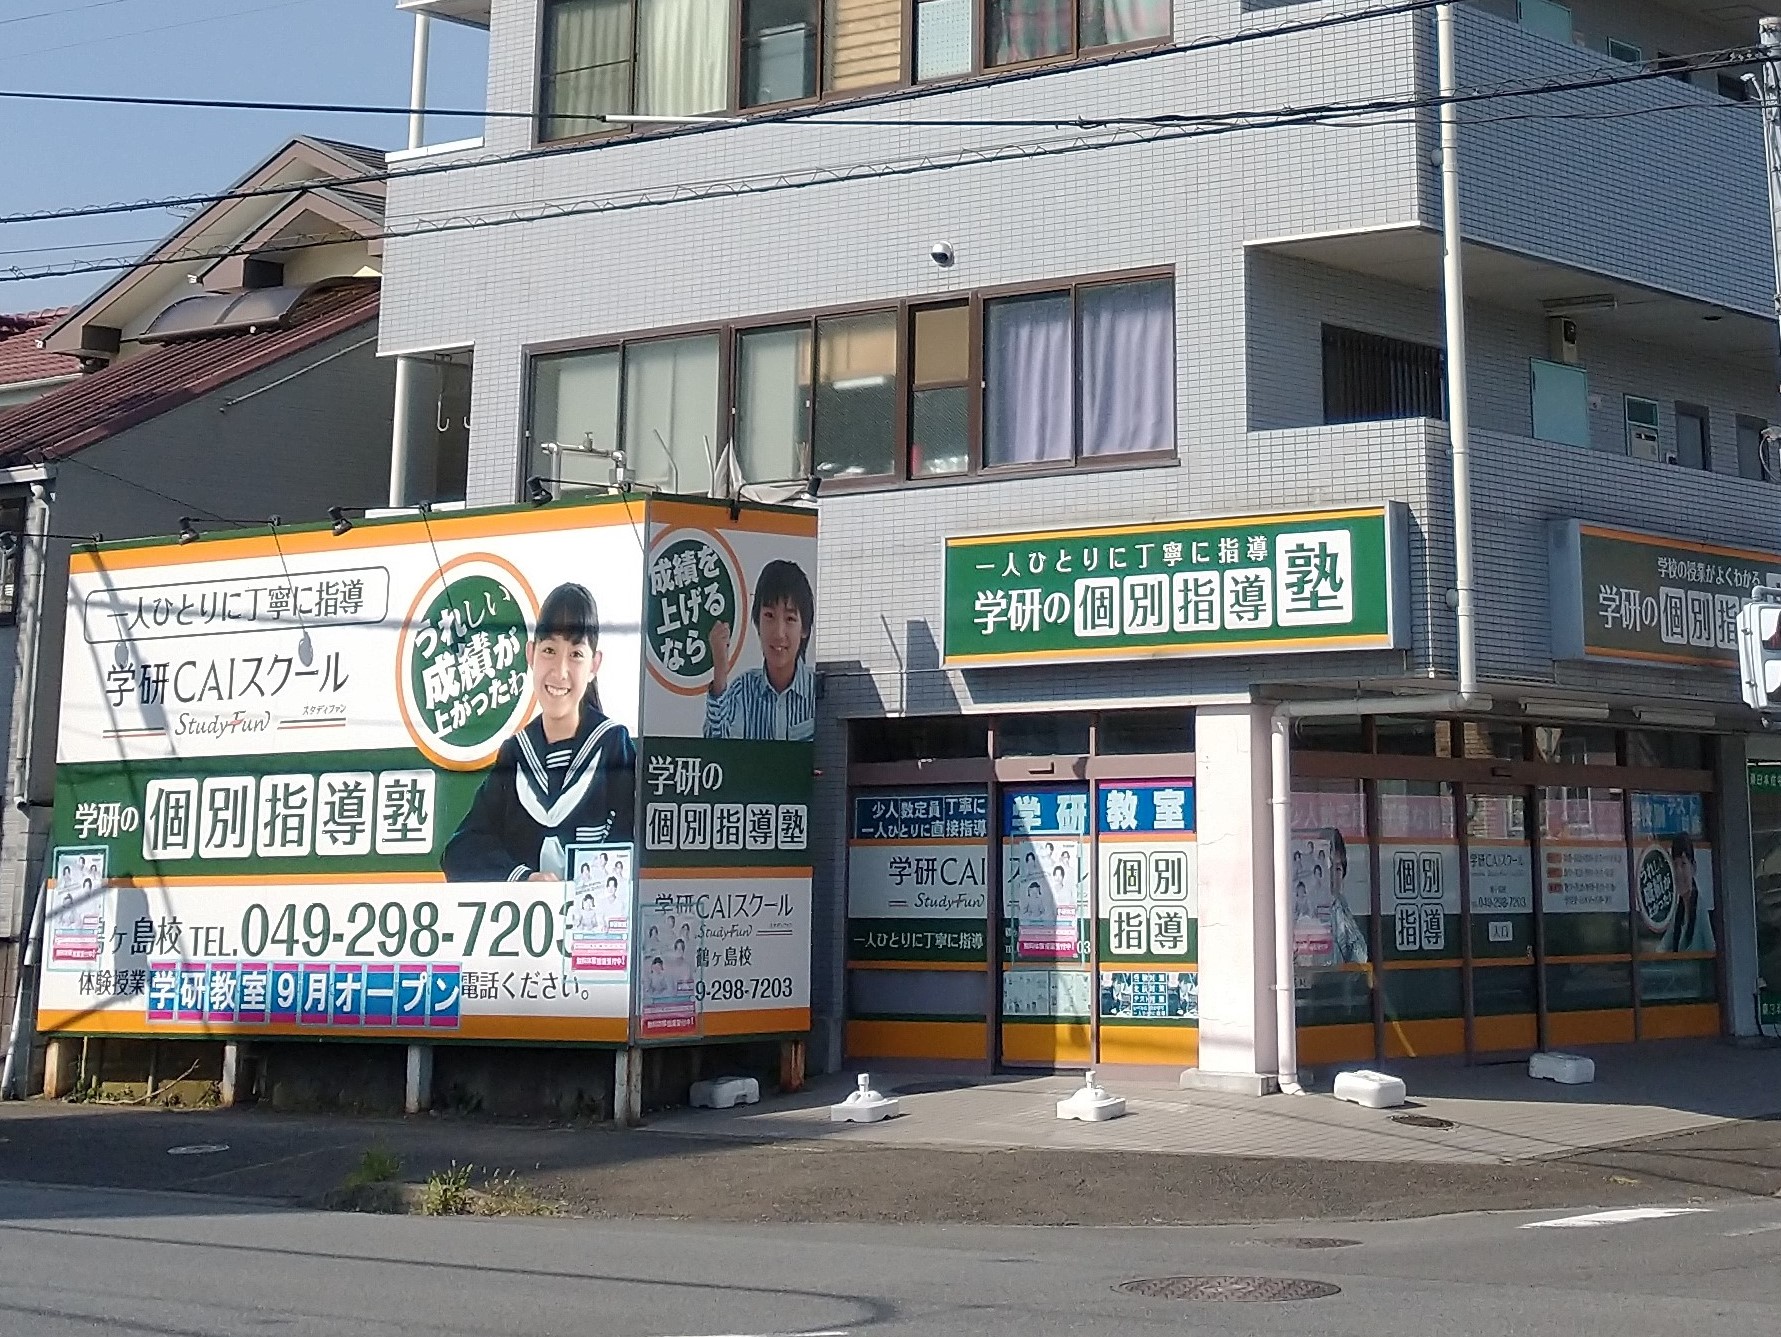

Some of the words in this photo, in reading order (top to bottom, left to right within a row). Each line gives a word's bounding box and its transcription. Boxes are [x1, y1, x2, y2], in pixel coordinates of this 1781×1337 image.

[650, 545, 720, 595] 成績を
[975, 535, 1268, 578] 一人ひとりに丁寧に指導
[107, 579, 364, 630] 一人ひとりに丁寧に指導
[415, 585, 511, 659] うれしい
[657, 582, 725, 635] 上げる
[1598, 585, 1739, 644] 学研の個別指
[422, 626, 520, 710] 成績が
[660, 630, 706, 671] なら
[106, 651, 349, 707] 学研CAIスクール
[648, 756, 723, 796] 学研の
[649, 808, 805, 845] 個別指導塾
[79, 969, 146, 996] 体験授業
[695, 977, 793, 1001] 9-298-7203
